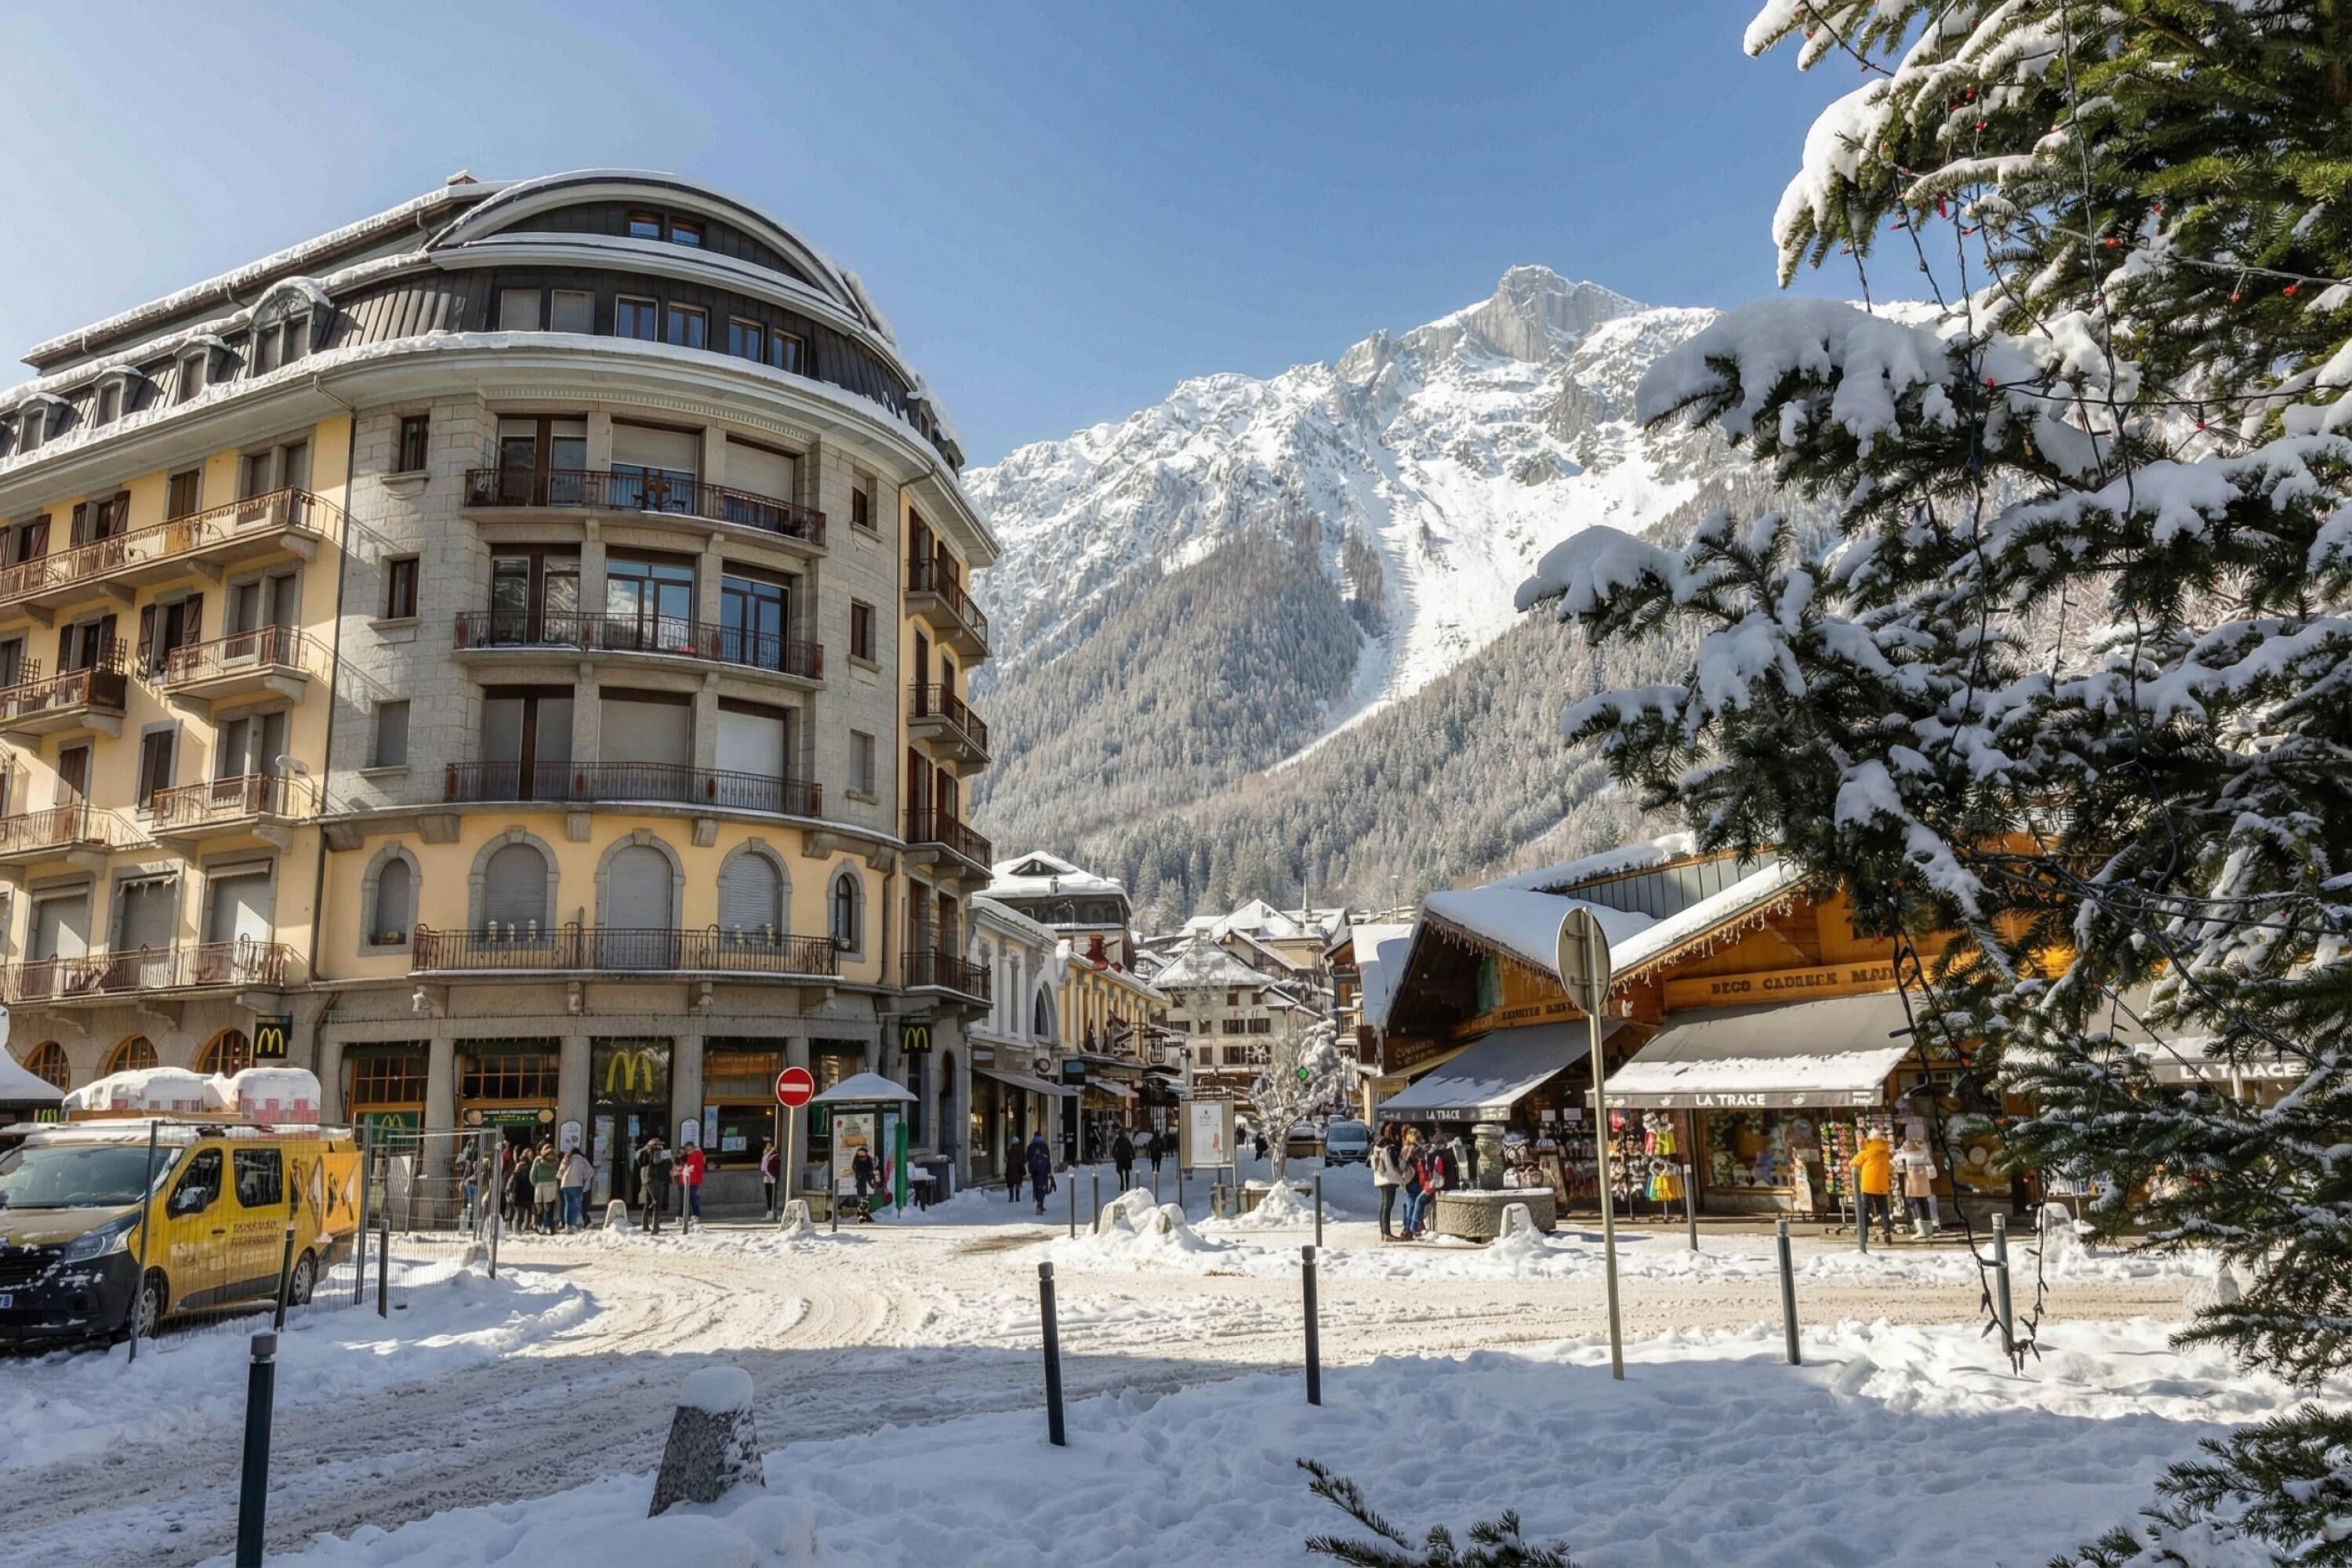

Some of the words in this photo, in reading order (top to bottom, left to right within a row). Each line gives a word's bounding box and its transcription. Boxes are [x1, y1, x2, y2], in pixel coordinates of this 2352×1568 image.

[2180, 1065, 2212, 1079] LA
[2215, 1062, 2307, 1078] TACE
[1695, 1094, 1715, 1105] LA
[1717, 1093, 1766, 1105] TRACE
[1426, 1109, 1436, 1120] LA
